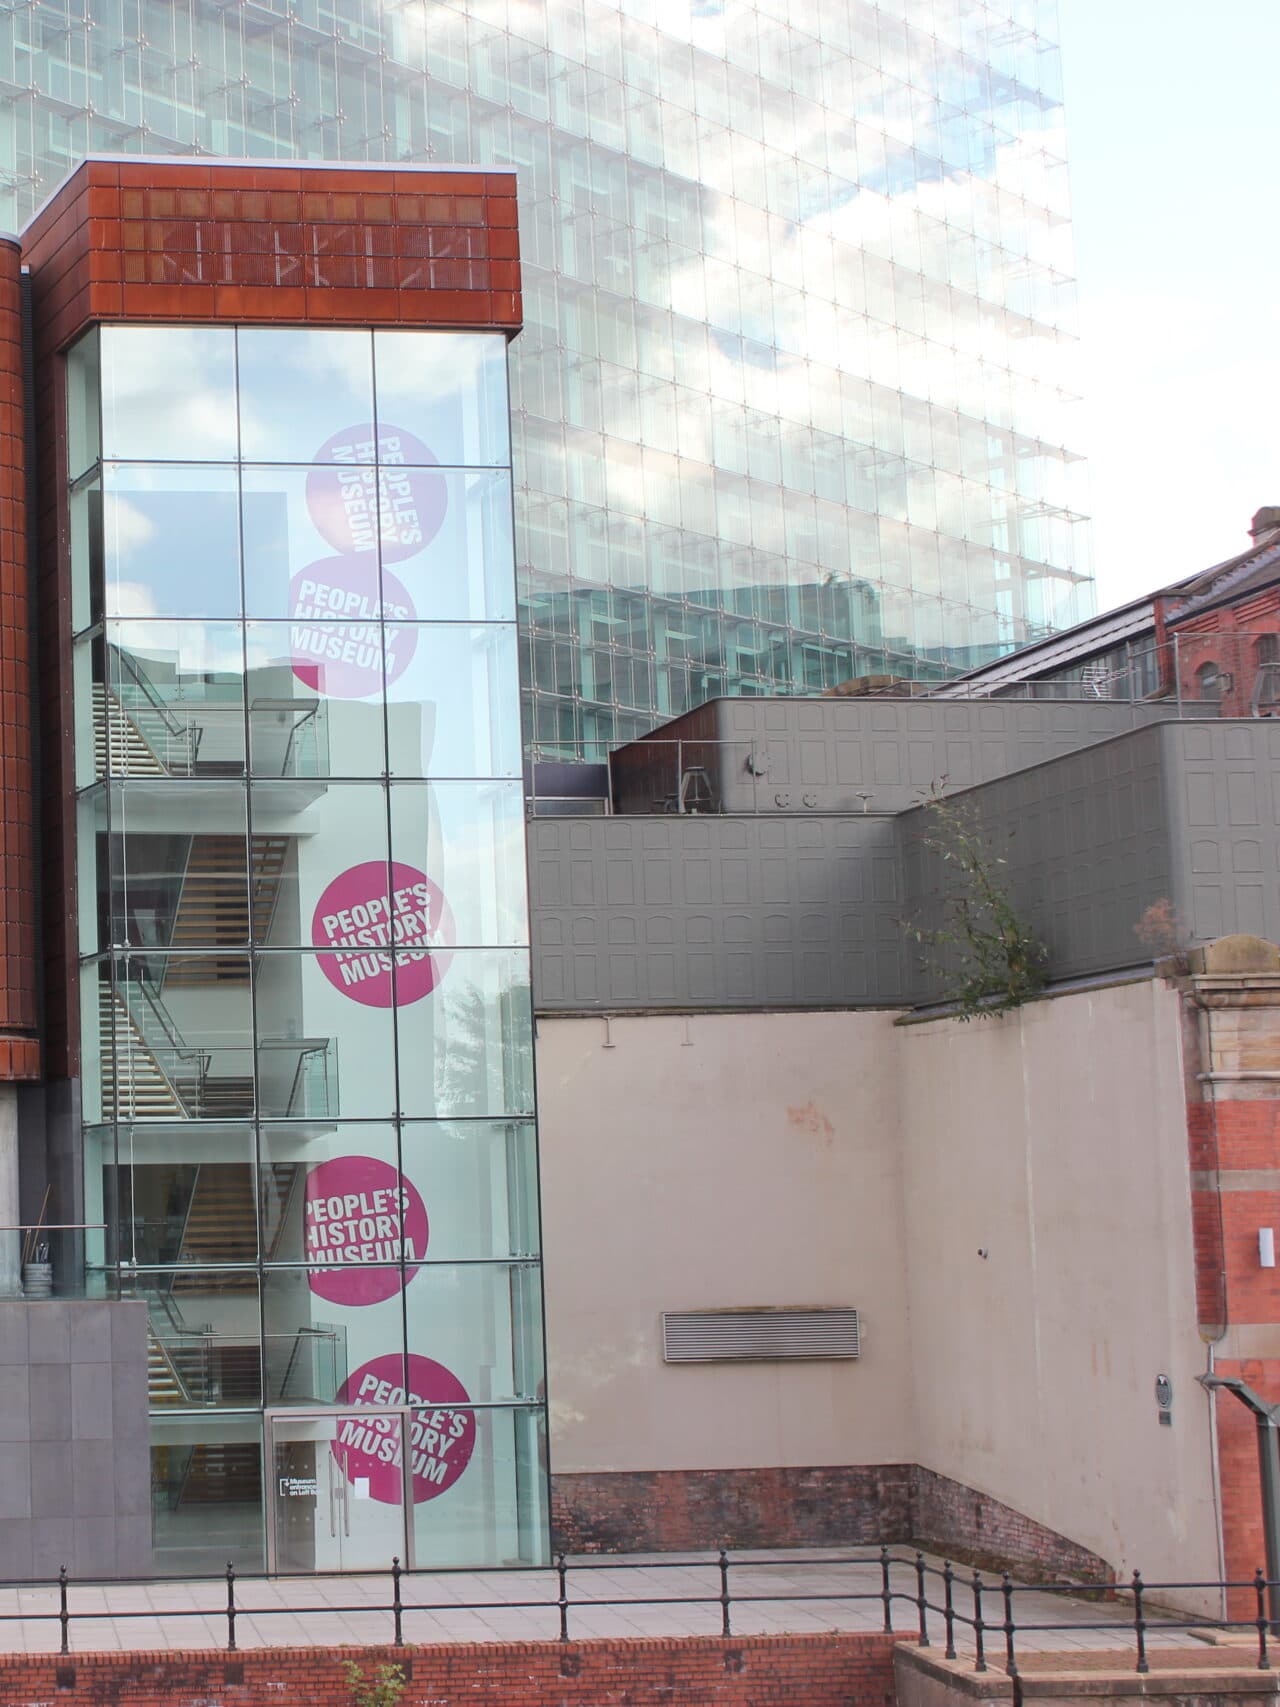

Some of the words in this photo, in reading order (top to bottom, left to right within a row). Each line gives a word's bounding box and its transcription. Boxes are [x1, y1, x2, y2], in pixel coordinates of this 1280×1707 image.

[332, 445, 376, 552] MUSEUM
[356, 440, 399, 542] HSTORY
[291, 626, 396, 674] MUSEUM
[322, 883, 431, 939] PEOPLE'S
[331, 907, 432, 961] HISTORY
